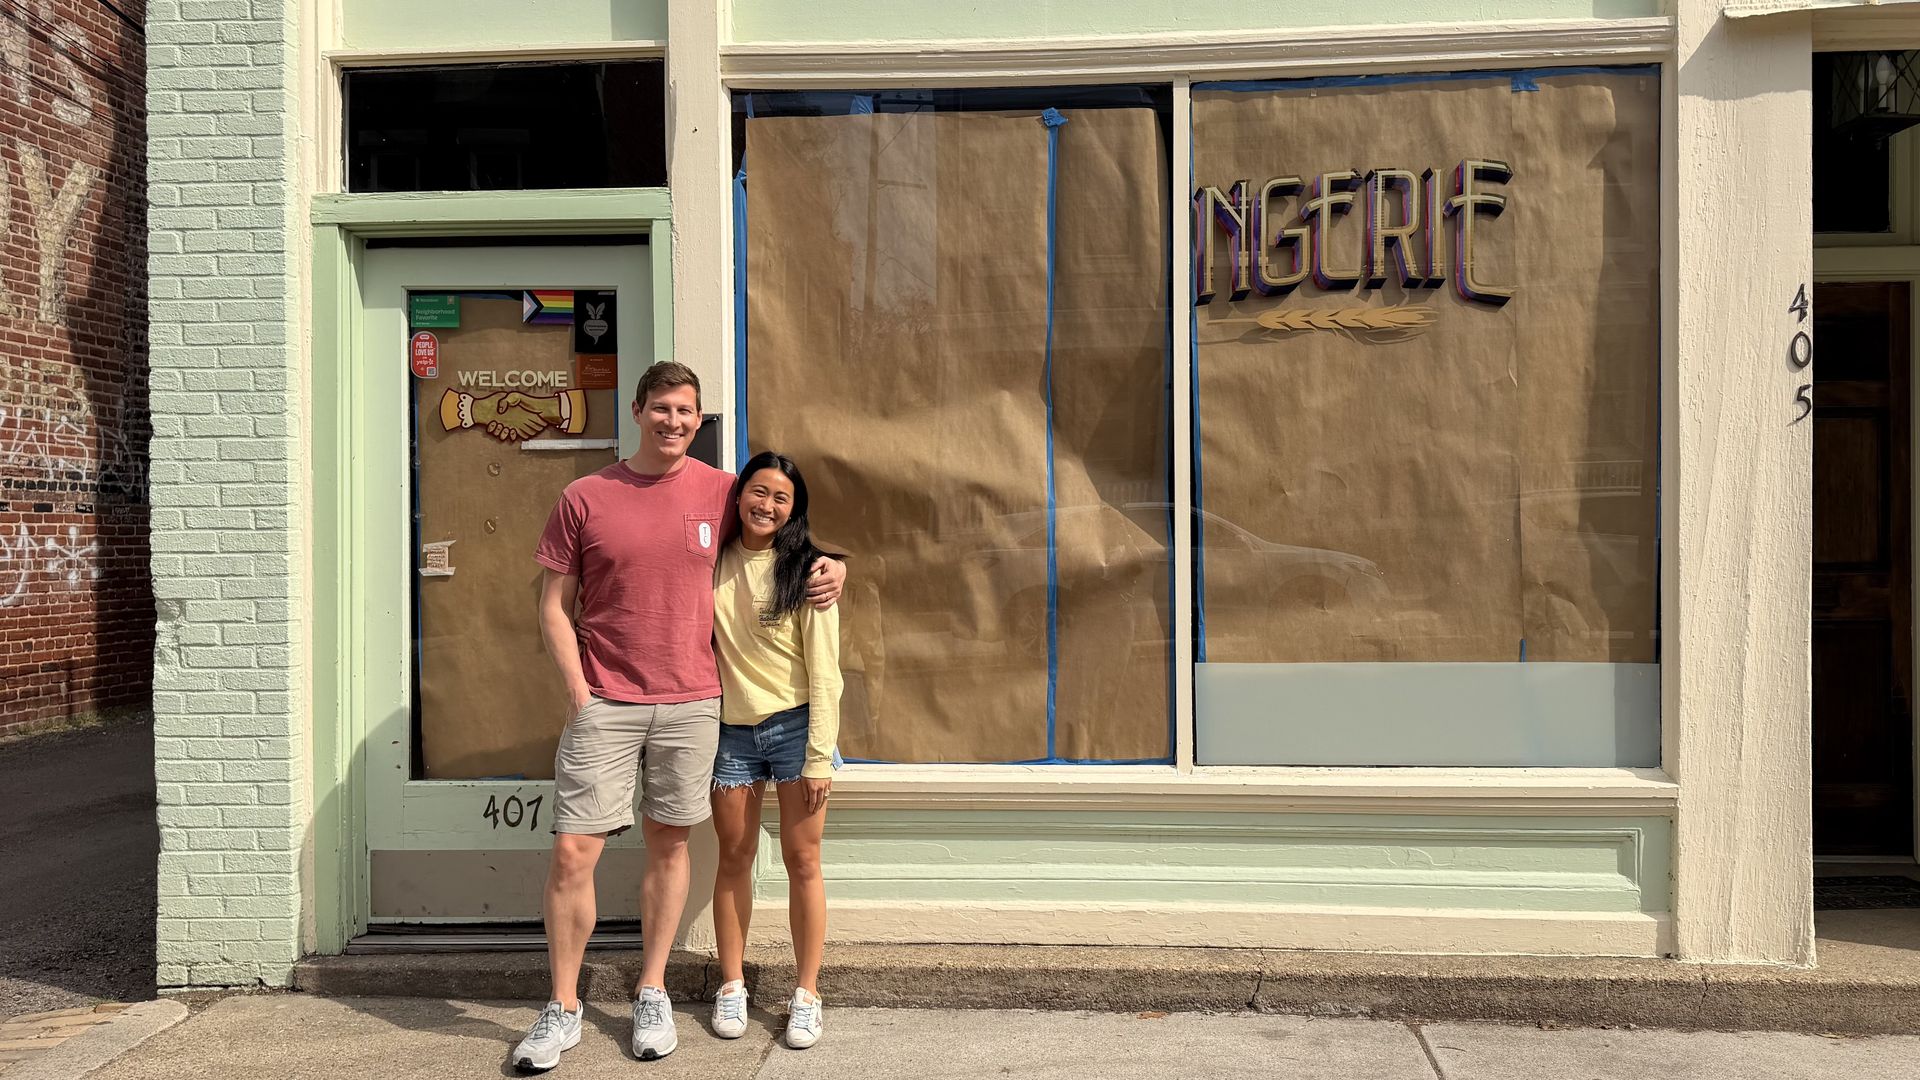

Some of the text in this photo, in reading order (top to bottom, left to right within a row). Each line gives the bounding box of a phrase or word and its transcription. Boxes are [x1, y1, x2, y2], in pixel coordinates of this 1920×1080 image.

[1193, 158, 1516, 306] NGERIE
[415, 341, 434, 349] PEOPLE
[1788, 283, 1812, 425] 405
[457, 370, 568, 387] WELCOME
[483, 794, 543, 831] 407
